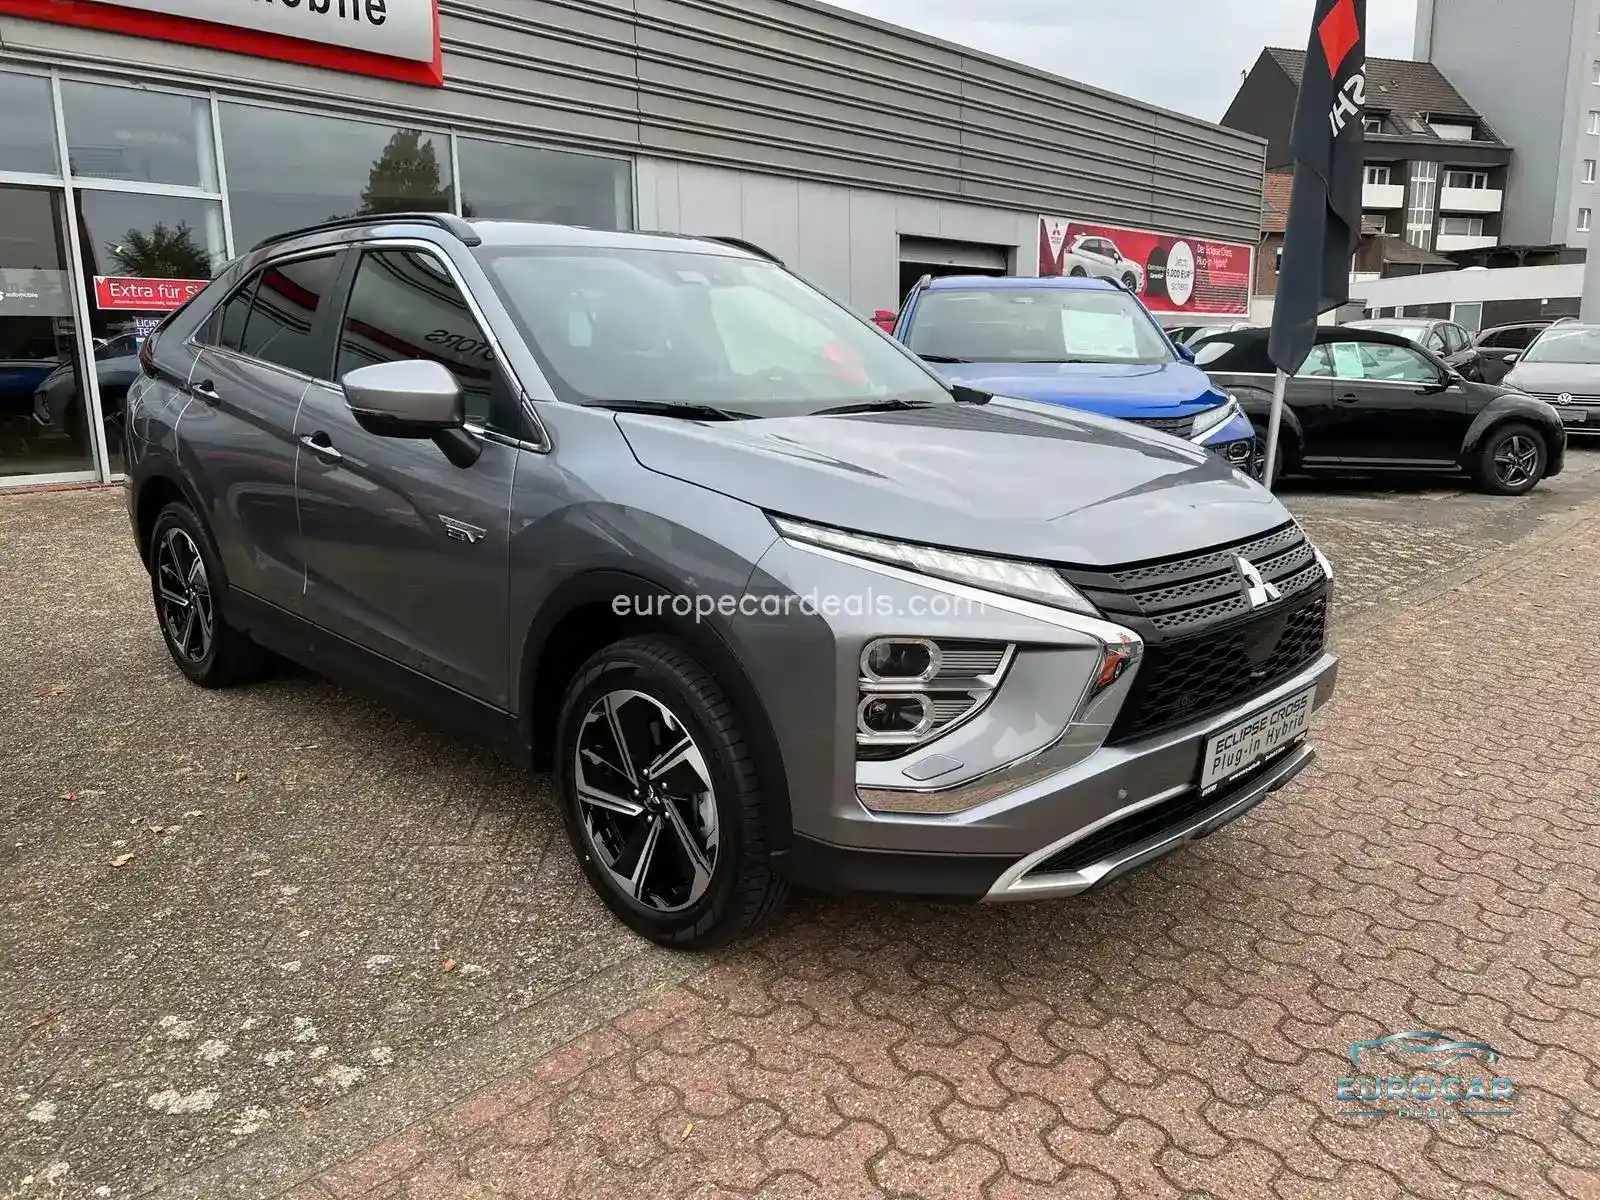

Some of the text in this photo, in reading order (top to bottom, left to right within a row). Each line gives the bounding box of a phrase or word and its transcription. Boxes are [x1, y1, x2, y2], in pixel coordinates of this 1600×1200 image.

[109, 283, 153, 298] Extra
[157, 284, 180, 299] für
[1212, 739, 1260, 775] Plug-in
[1265, 711, 1305, 746] Hybrid
[1215, 716, 1268, 755] ECLIPSE
[1269, 694, 1308, 725] CROSS
